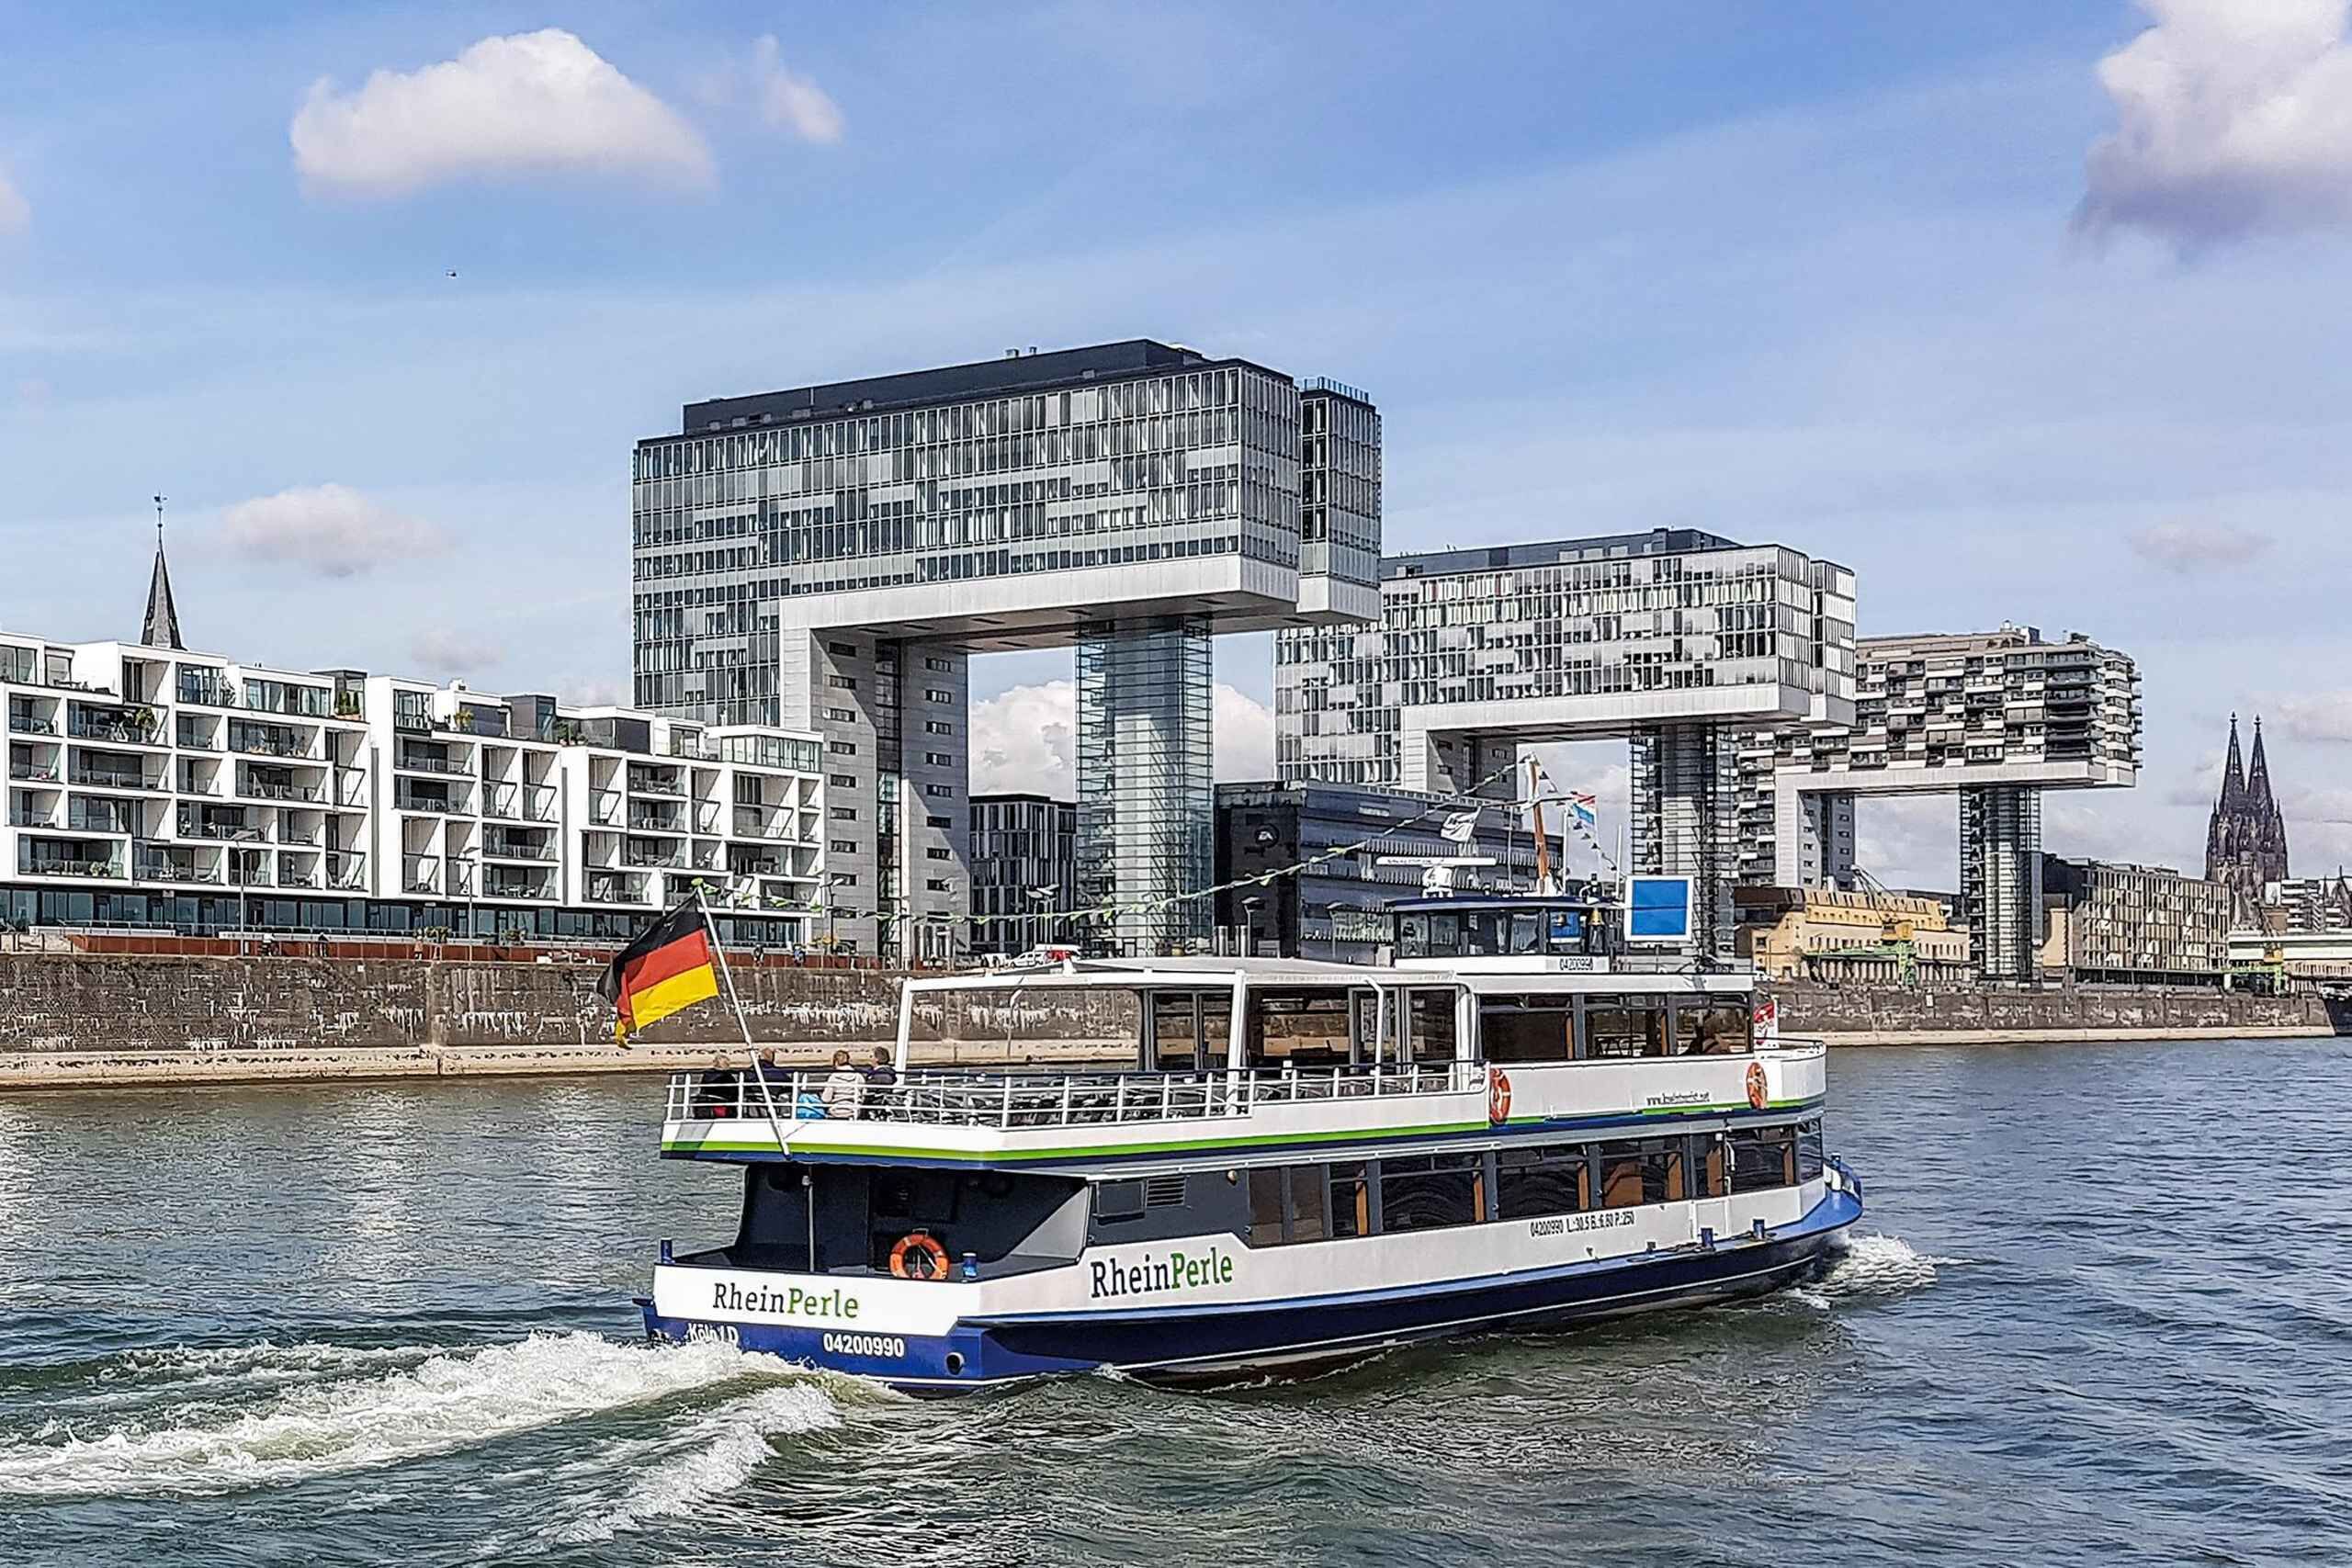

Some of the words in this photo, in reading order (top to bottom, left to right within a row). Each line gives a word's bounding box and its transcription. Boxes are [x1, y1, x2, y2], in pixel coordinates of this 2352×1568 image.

[1090, 1247, 1234, 1298] RheinPerle
[712, 1282, 859, 1319] RheinPerle
[823, 1333, 905, 1358] 04200990
